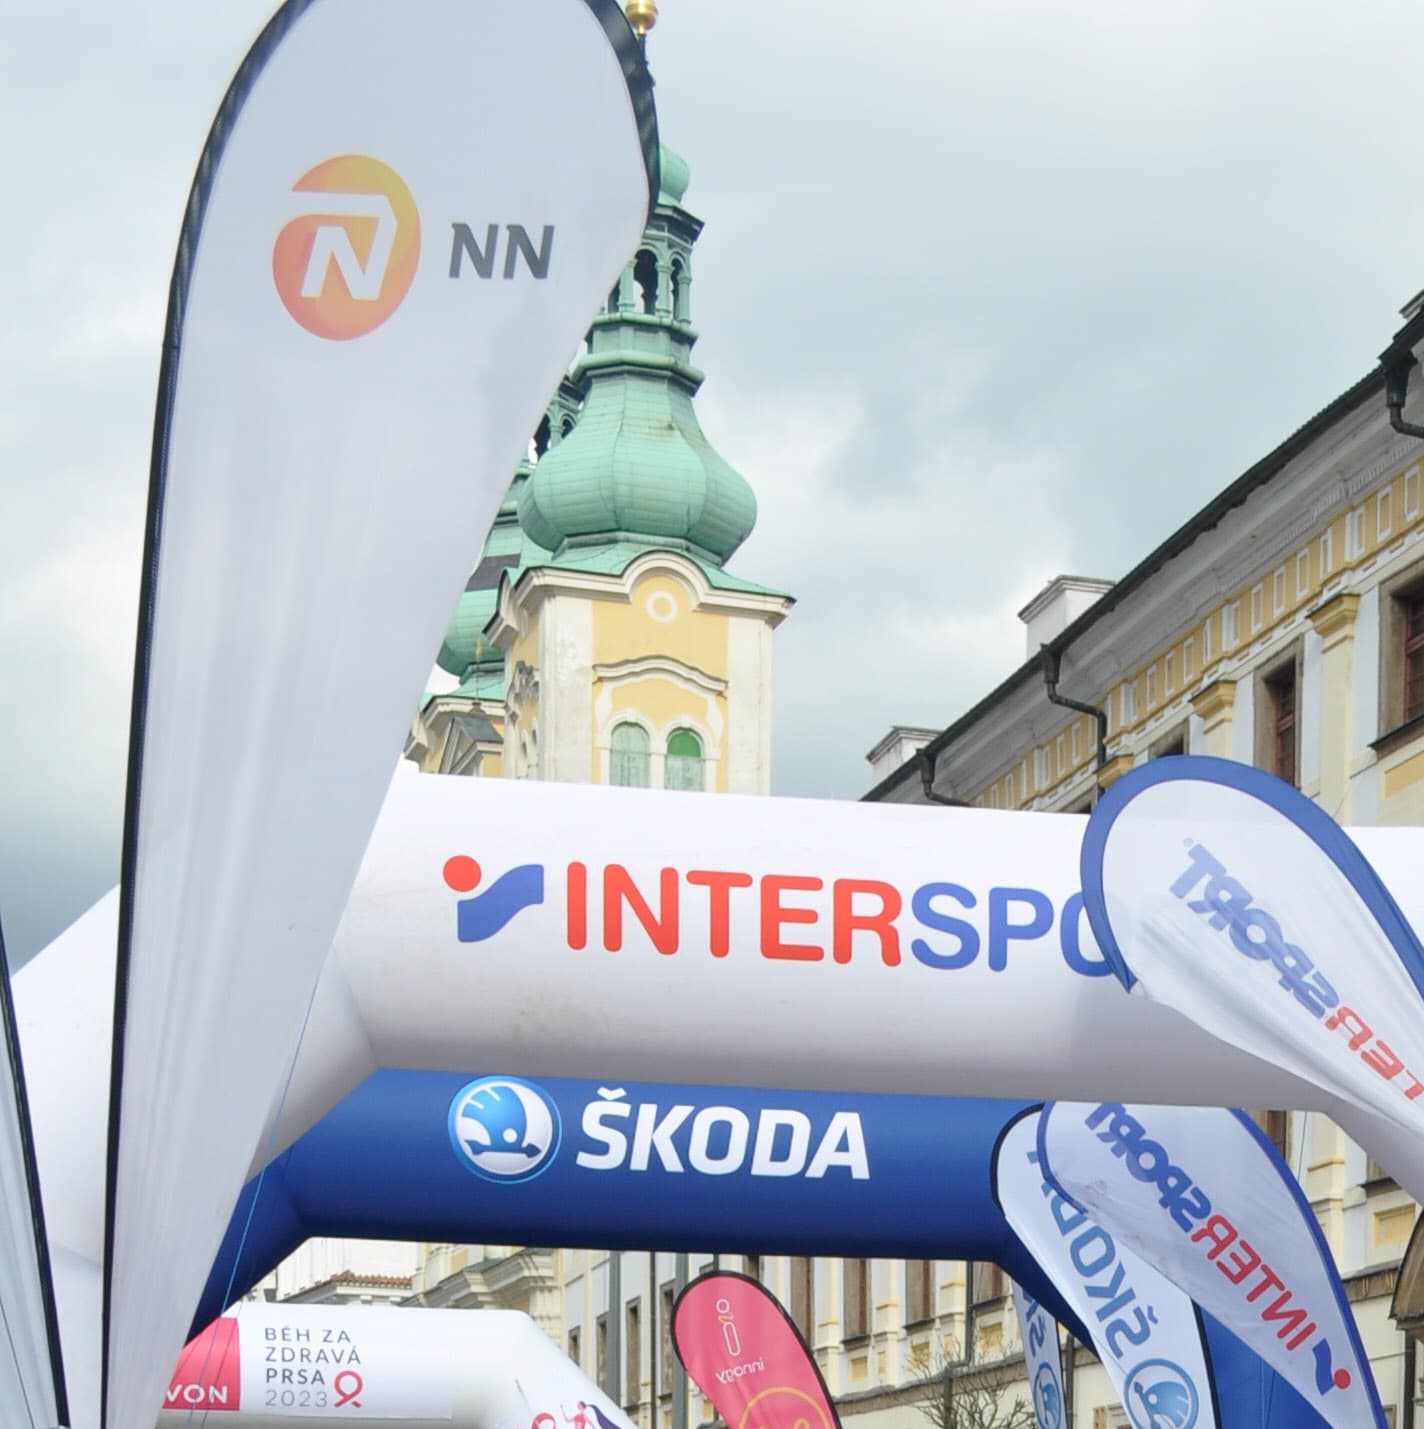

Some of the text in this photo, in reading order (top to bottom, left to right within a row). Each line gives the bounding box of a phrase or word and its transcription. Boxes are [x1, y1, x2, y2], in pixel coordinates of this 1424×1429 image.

[448, 222, 556, 280] NN
[576, 1086, 871, 1181] ŠKODA
[264, 1326, 351, 1344] BĚH ZA
[264, 1345, 361, 1365] ZDRAVÁ
[265, 1368, 326, 1386] PRSA
[164, 1384, 229, 1405] VON
[264, 1390, 328, 1409] 2023
